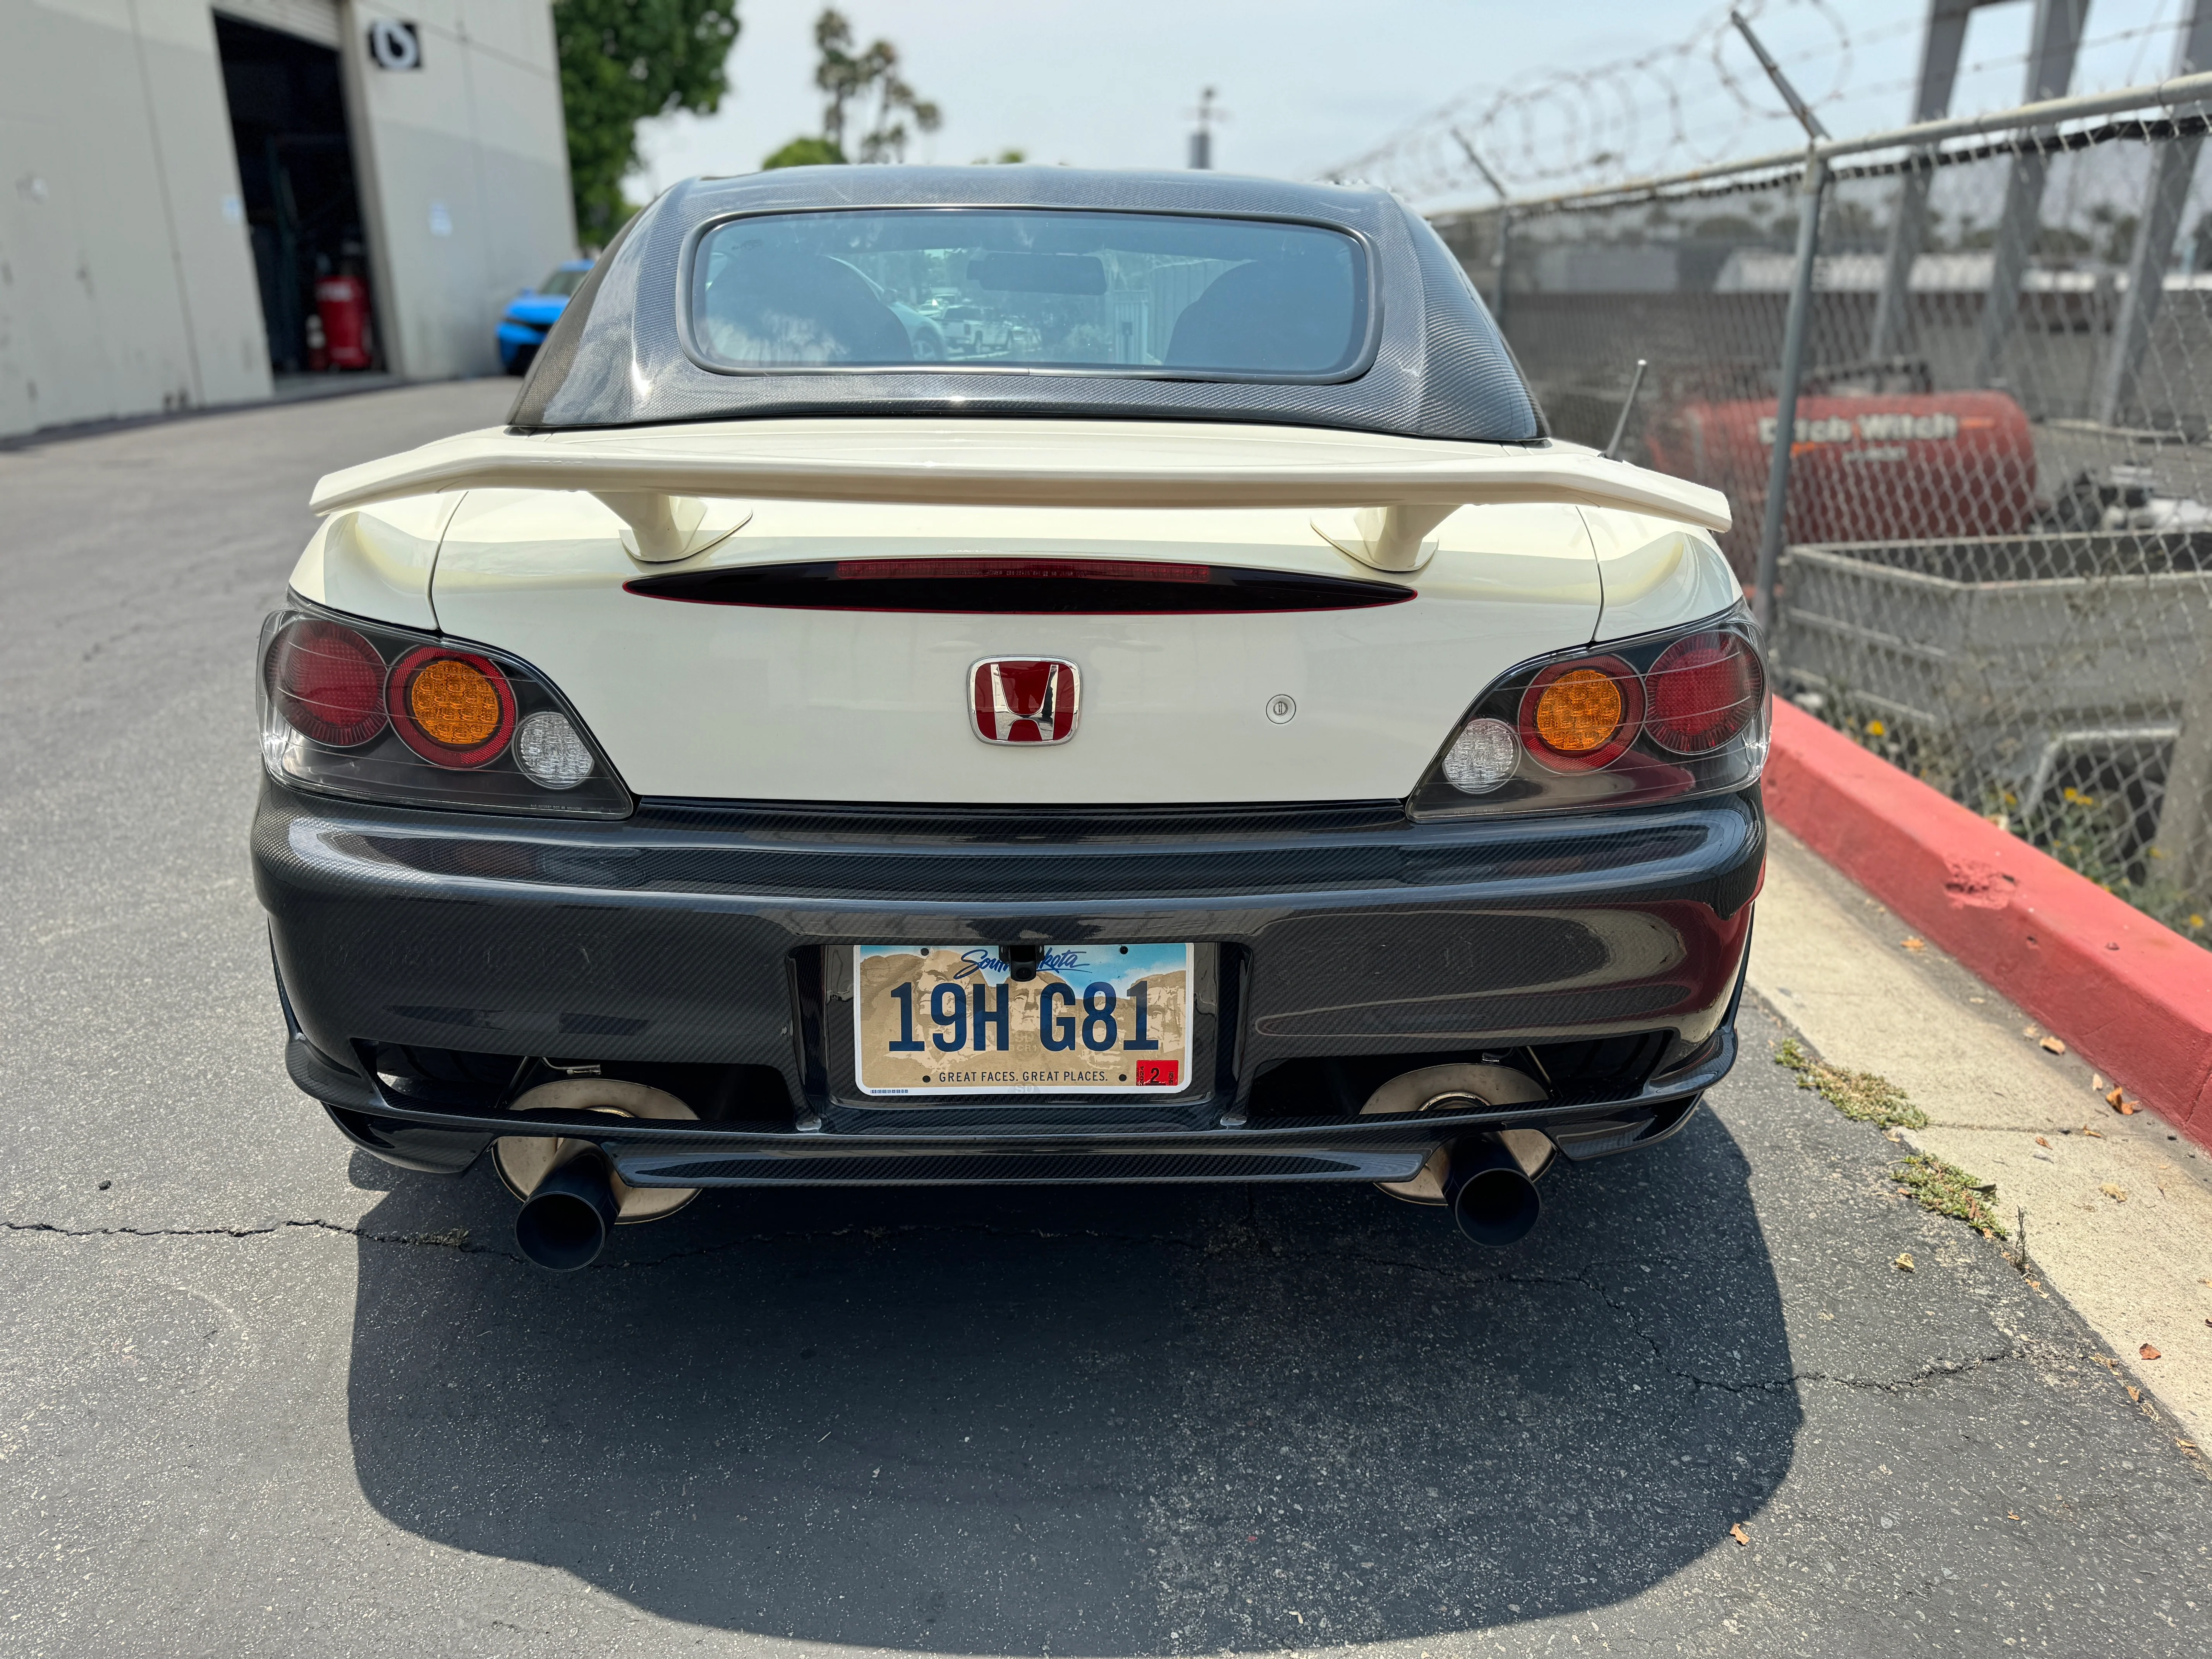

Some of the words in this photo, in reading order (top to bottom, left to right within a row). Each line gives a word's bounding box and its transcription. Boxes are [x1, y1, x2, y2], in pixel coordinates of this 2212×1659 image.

[889, 982, 1009, 1052] 19H
[1040, 981, 1159, 1051] G81
[939, 1072, 977, 1082] GREAT
[981, 1072, 1018, 1082] FACES.
[1023, 1071, 1059, 1081] GREAT
[1064, 1071, 1108, 1081] PLACES.
[1151, 1067, 1159, 1084] 2
